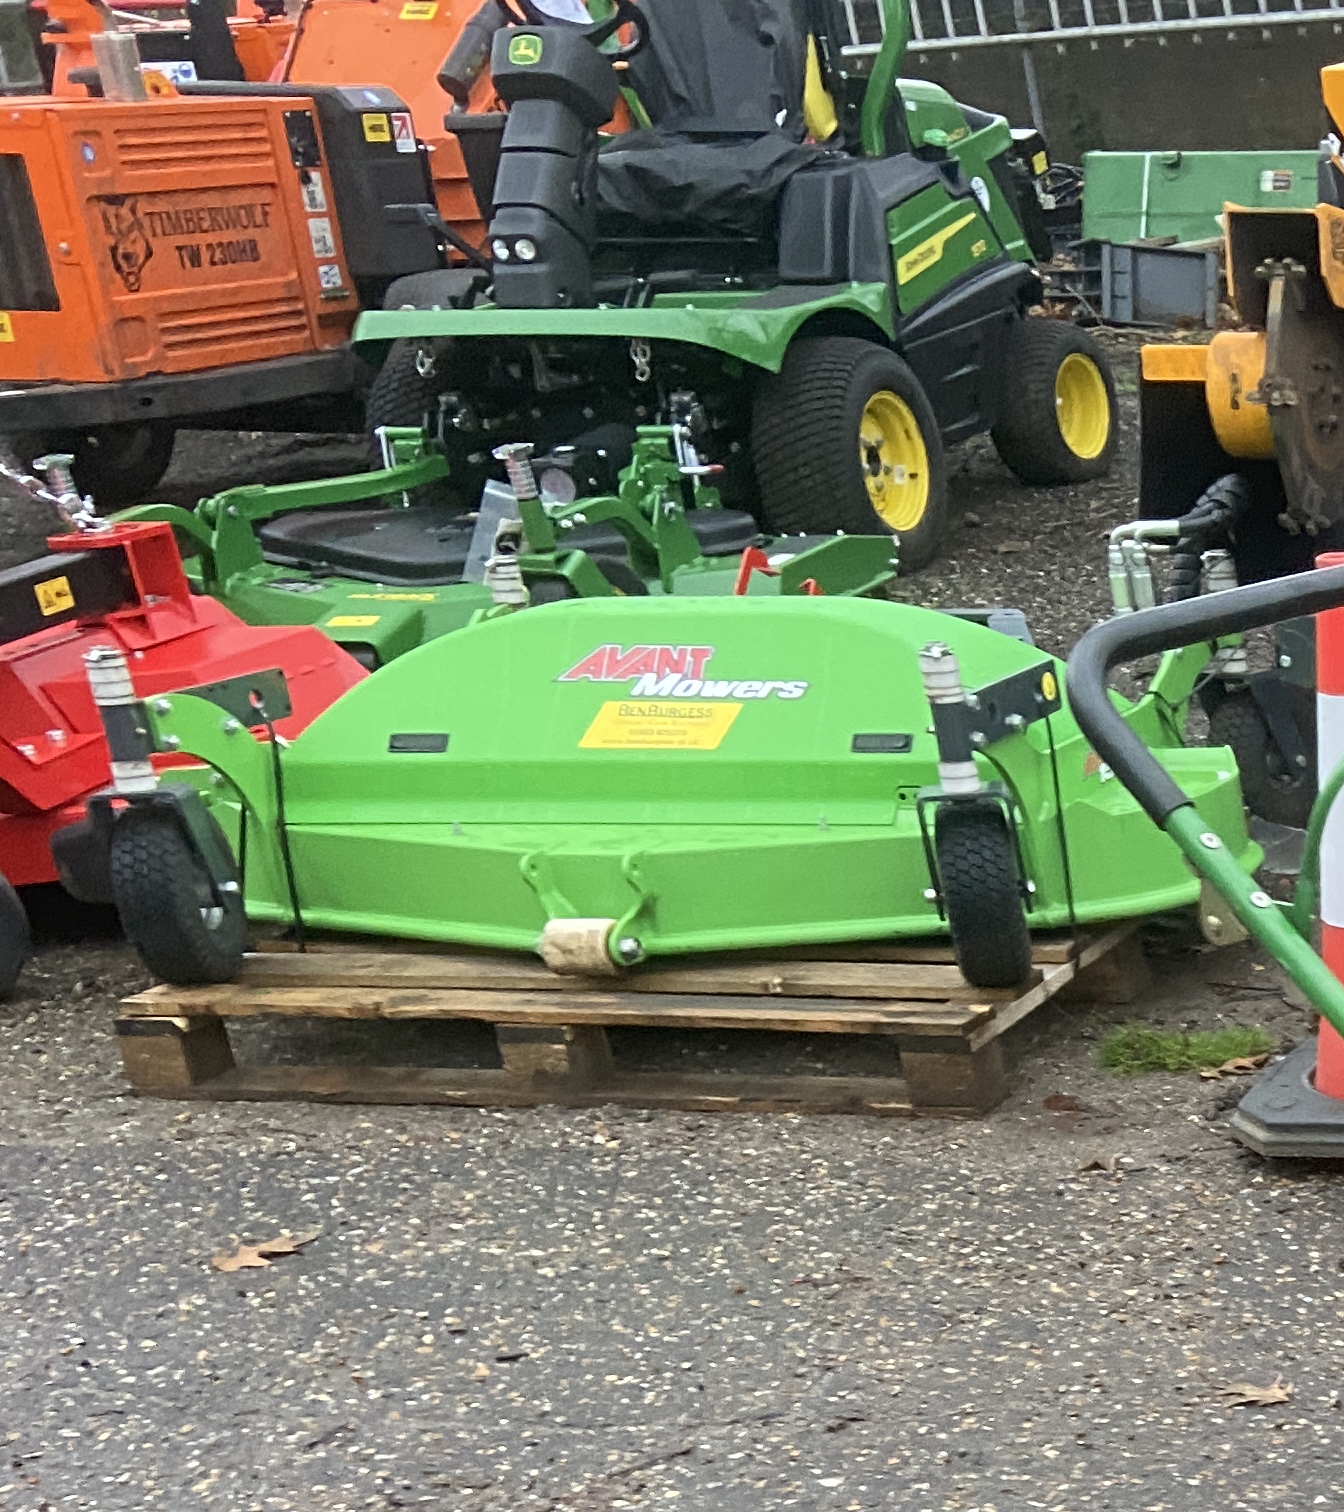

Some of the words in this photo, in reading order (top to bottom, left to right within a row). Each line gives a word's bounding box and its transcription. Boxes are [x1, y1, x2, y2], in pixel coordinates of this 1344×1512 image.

[143, 203, 272, 237] TIMBERWOLF
[175, 243, 202, 269] TW
[558, 645, 714, 682] AVANT
[629, 672, 808, 699] Mowers
